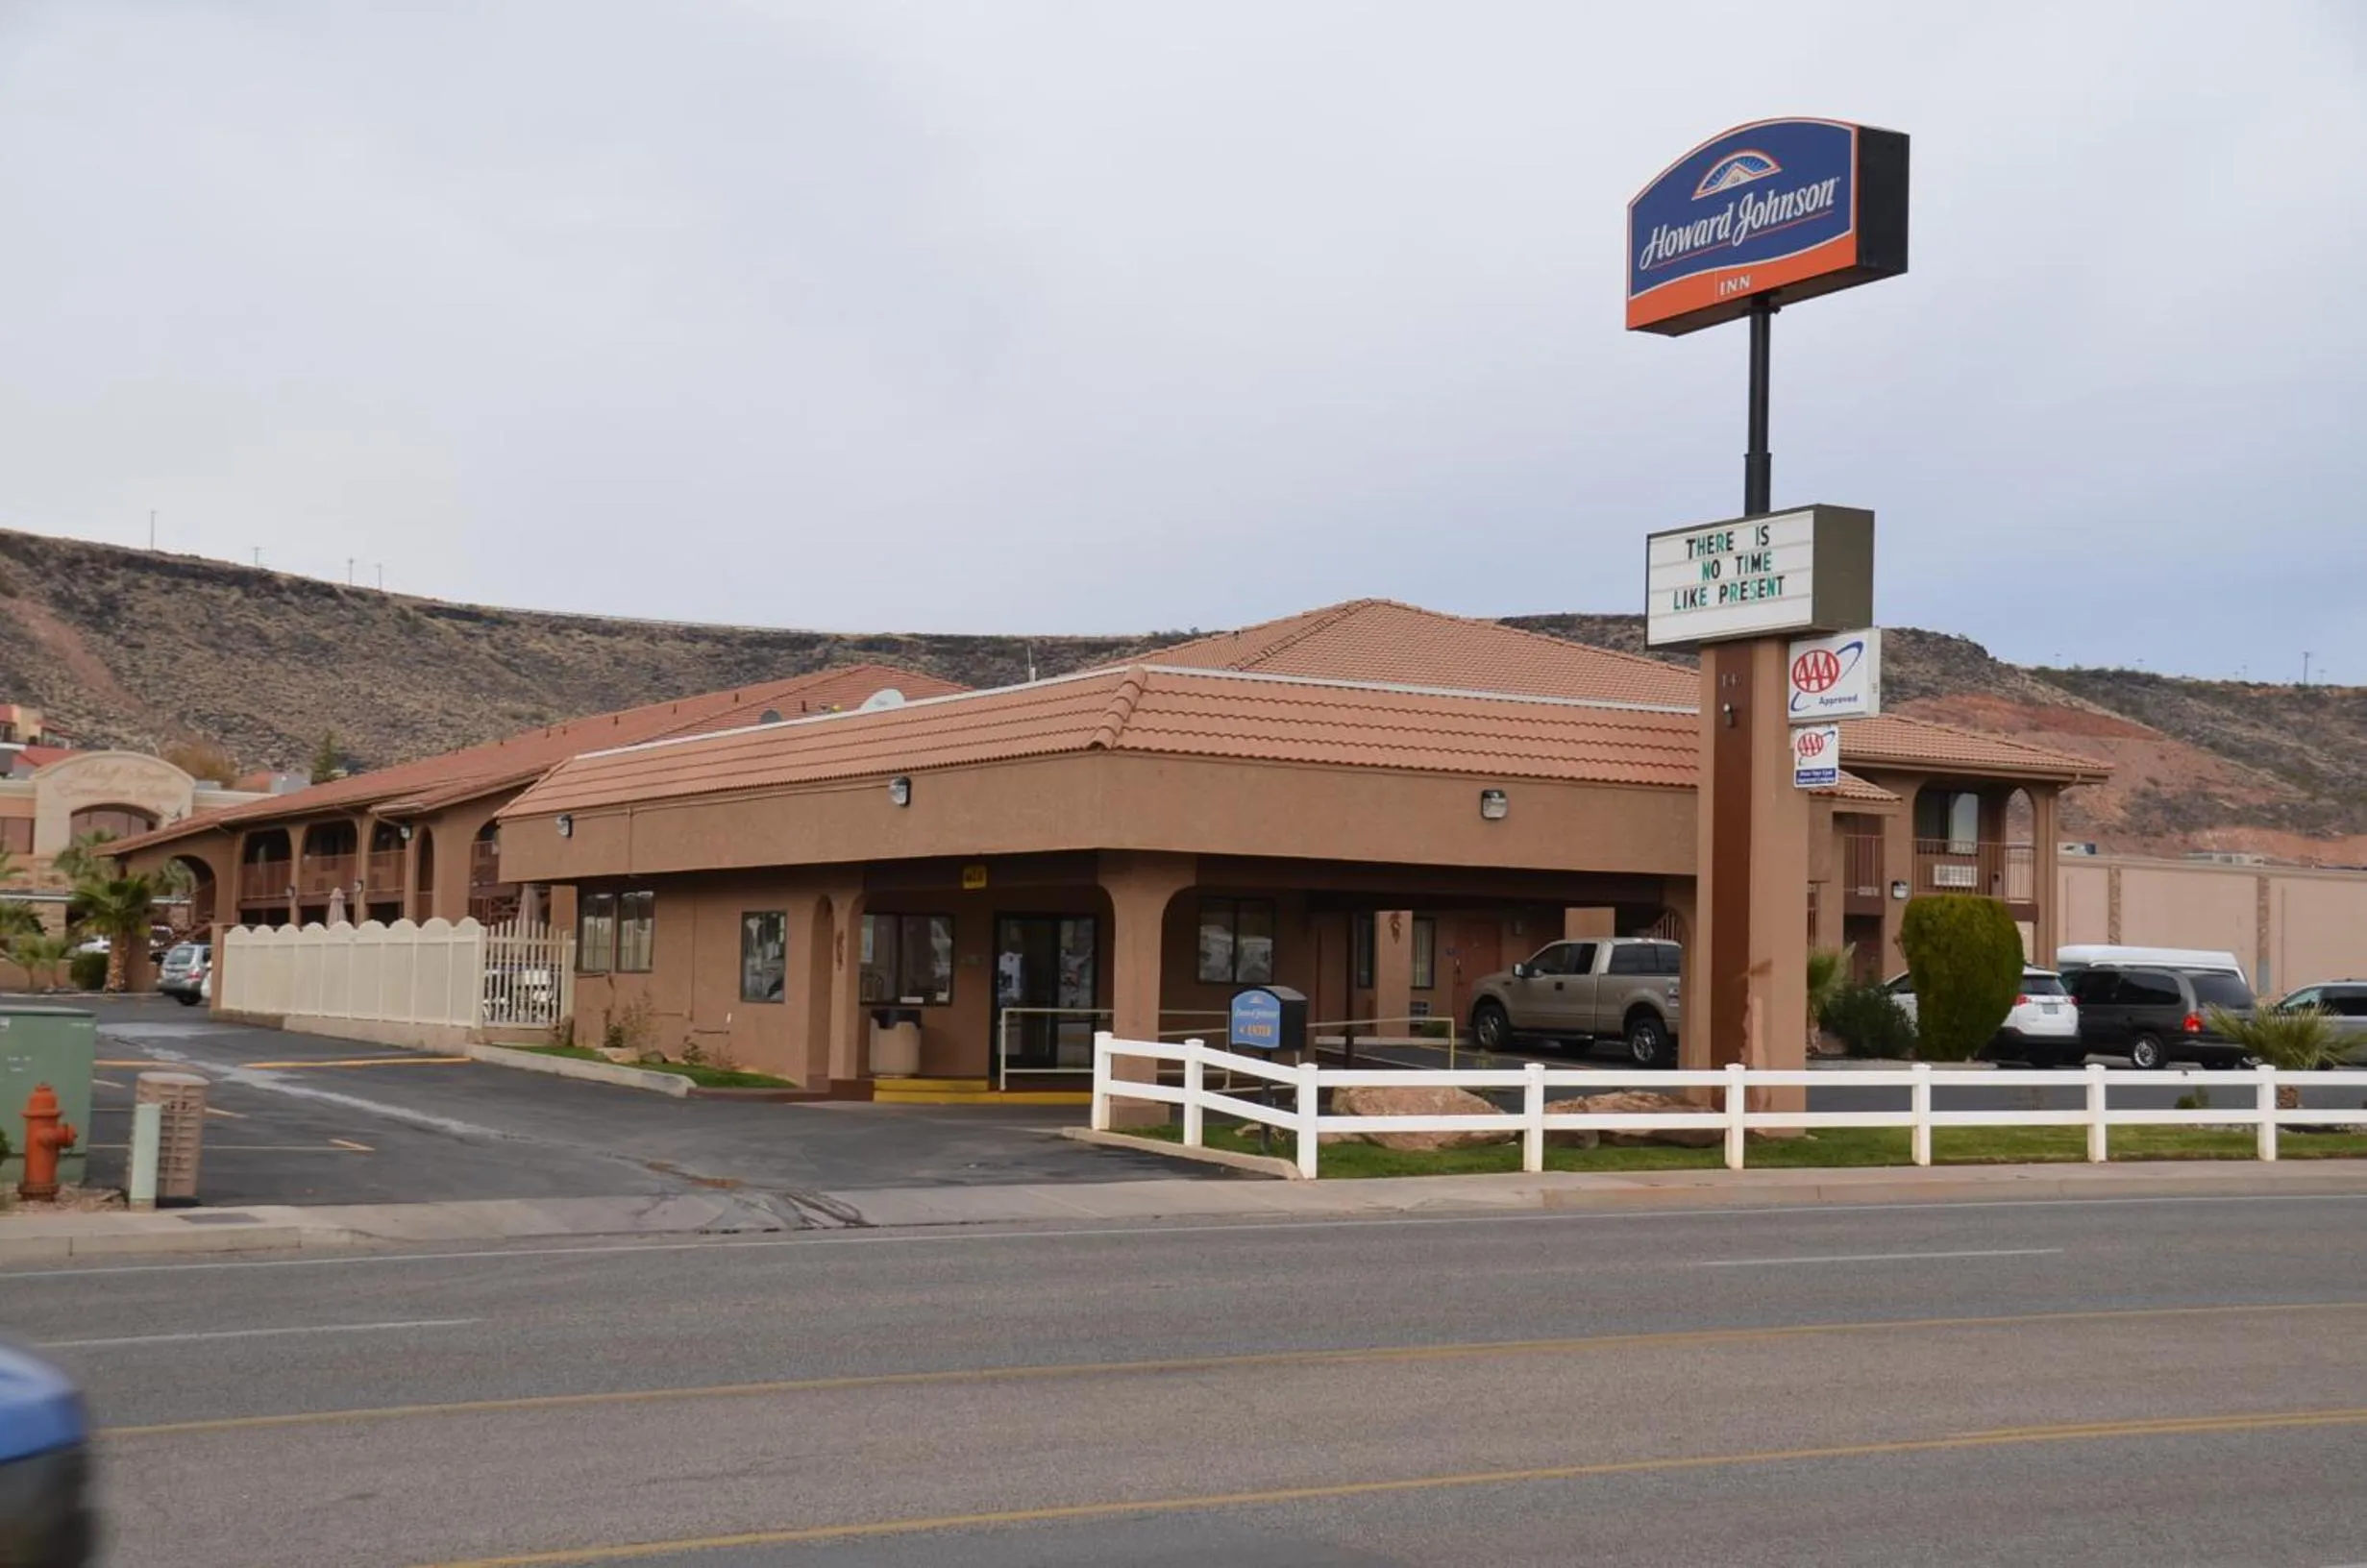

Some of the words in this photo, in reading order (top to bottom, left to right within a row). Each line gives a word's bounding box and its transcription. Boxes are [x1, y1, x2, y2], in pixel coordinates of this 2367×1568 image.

[1639, 202, 1732, 270] Howard
[1732, 178, 1837, 246] Johnson
[1719, 275, 1751, 296] INN
[1686, 530, 1735, 559] THERE
[1755, 525, 1770, 547] IS
[1702, 558, 1721, 581] NO
[1736, 551, 1773, 576] TIME
[1673, 586, 1708, 611] LIKE
[1718, 576, 1786, 605] PRESENT
[1796, 650, 1837, 693] AAA
[1818, 694, 1859, 707] Approved
